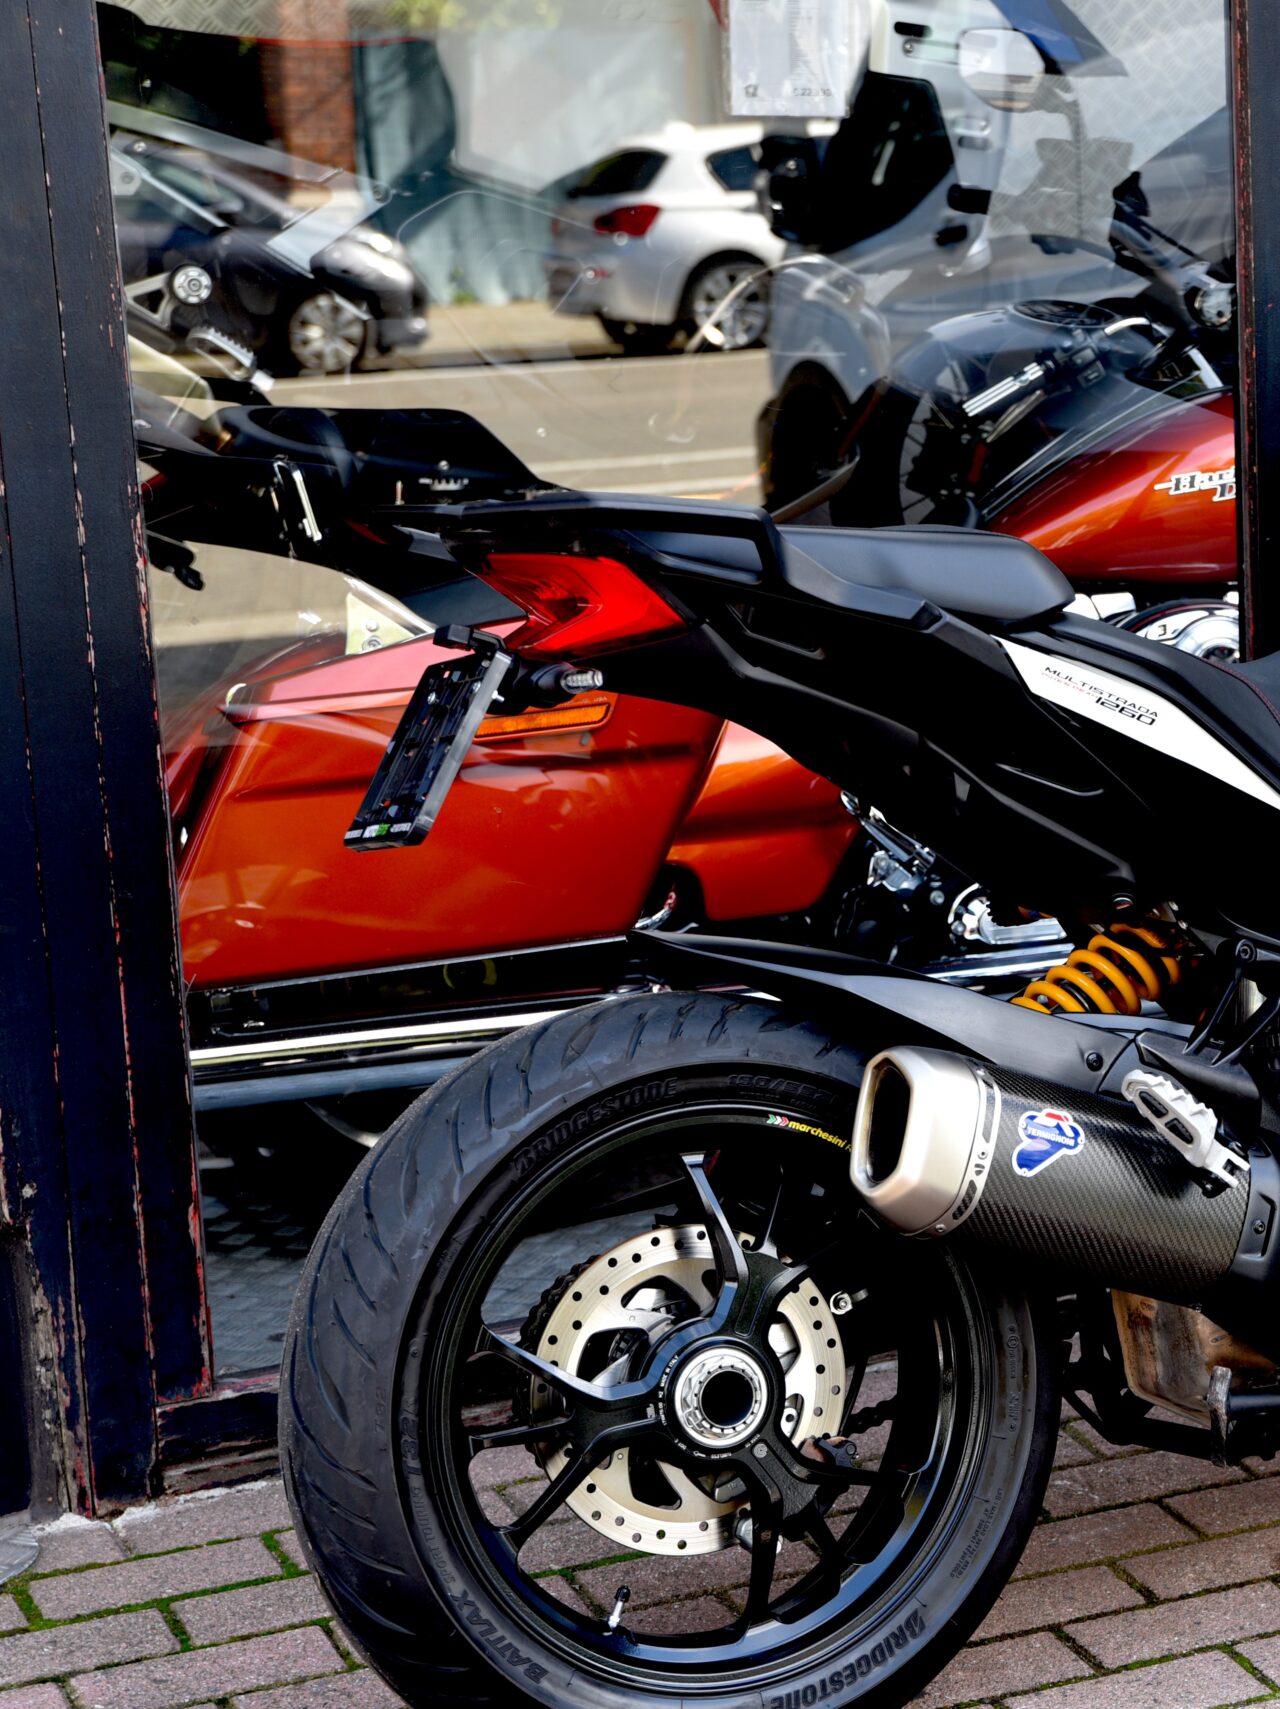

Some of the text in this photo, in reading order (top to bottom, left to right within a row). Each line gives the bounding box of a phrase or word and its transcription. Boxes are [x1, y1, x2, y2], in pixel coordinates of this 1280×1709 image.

[1044, 666, 1158, 718] MULTISTRADA
[1095, 696, 1156, 726] 1260
[510, 1076, 679, 1177] BRIDGESTONE
[788, 1120, 847, 1148] marchesini
[1026, 1126, 1075, 1147] TERMIGNONI
[450, 1588, 549, 1685] BATTLAX
[770, 1608, 927, 1709] BRIDGESTONE
